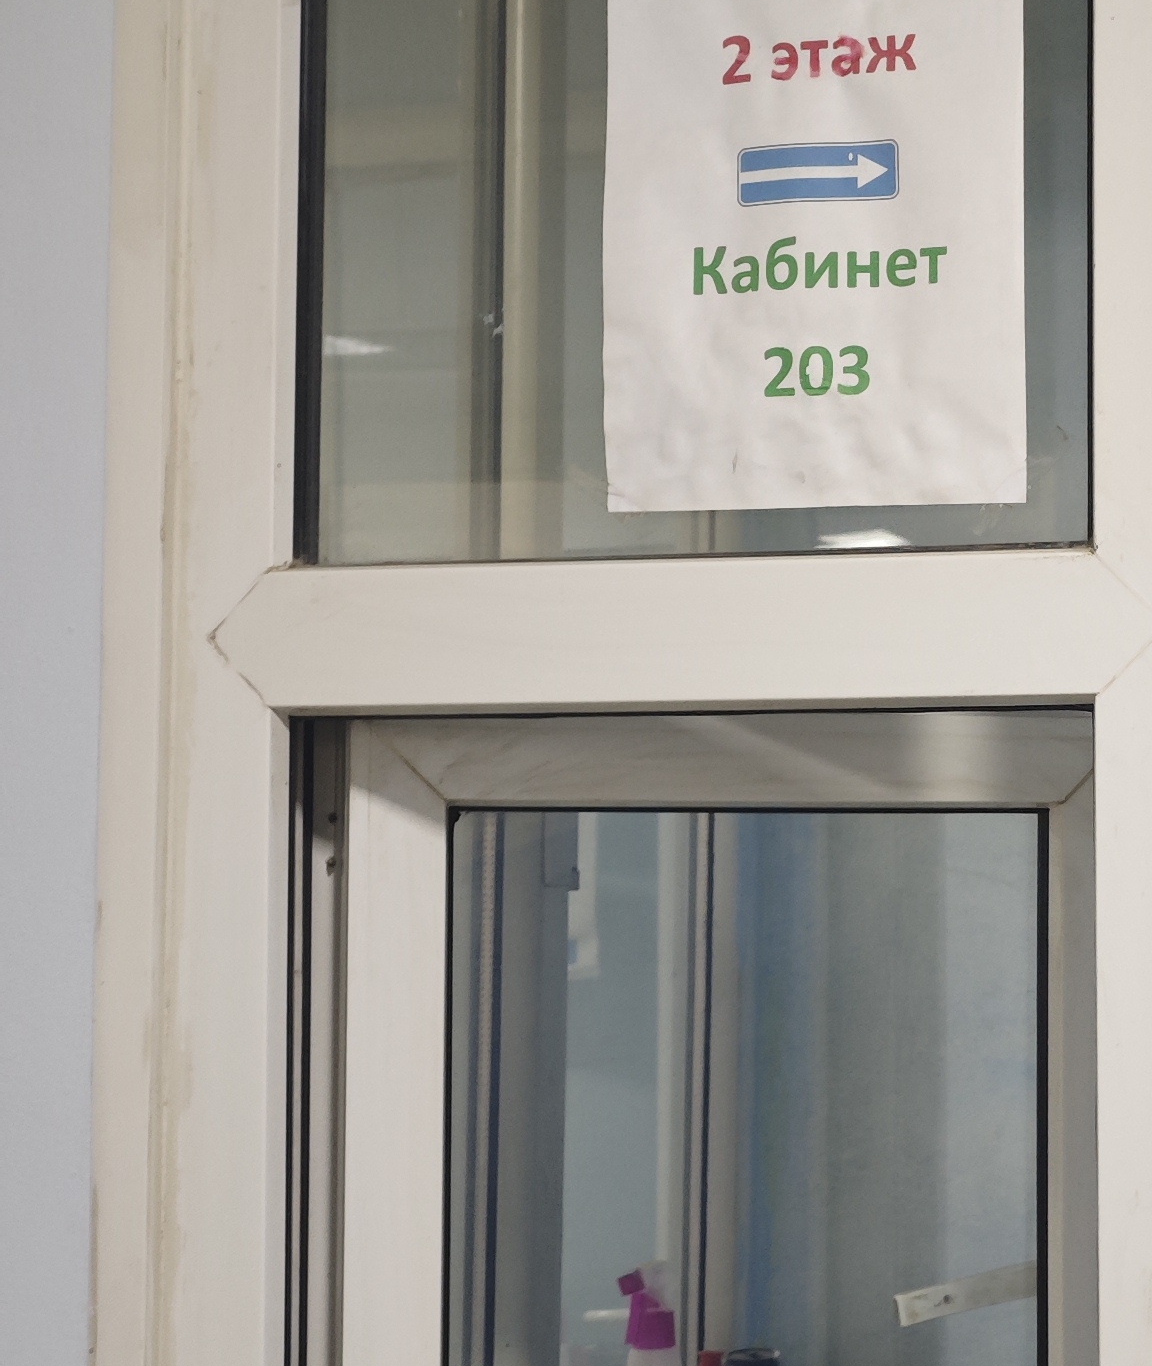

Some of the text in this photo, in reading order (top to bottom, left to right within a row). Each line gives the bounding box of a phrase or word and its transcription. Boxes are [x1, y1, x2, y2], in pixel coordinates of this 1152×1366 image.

[722, 34, 918, 85] 2 этаж
[693, 236, 948, 295] Кабинет
[763, 346, 871, 398] 203
